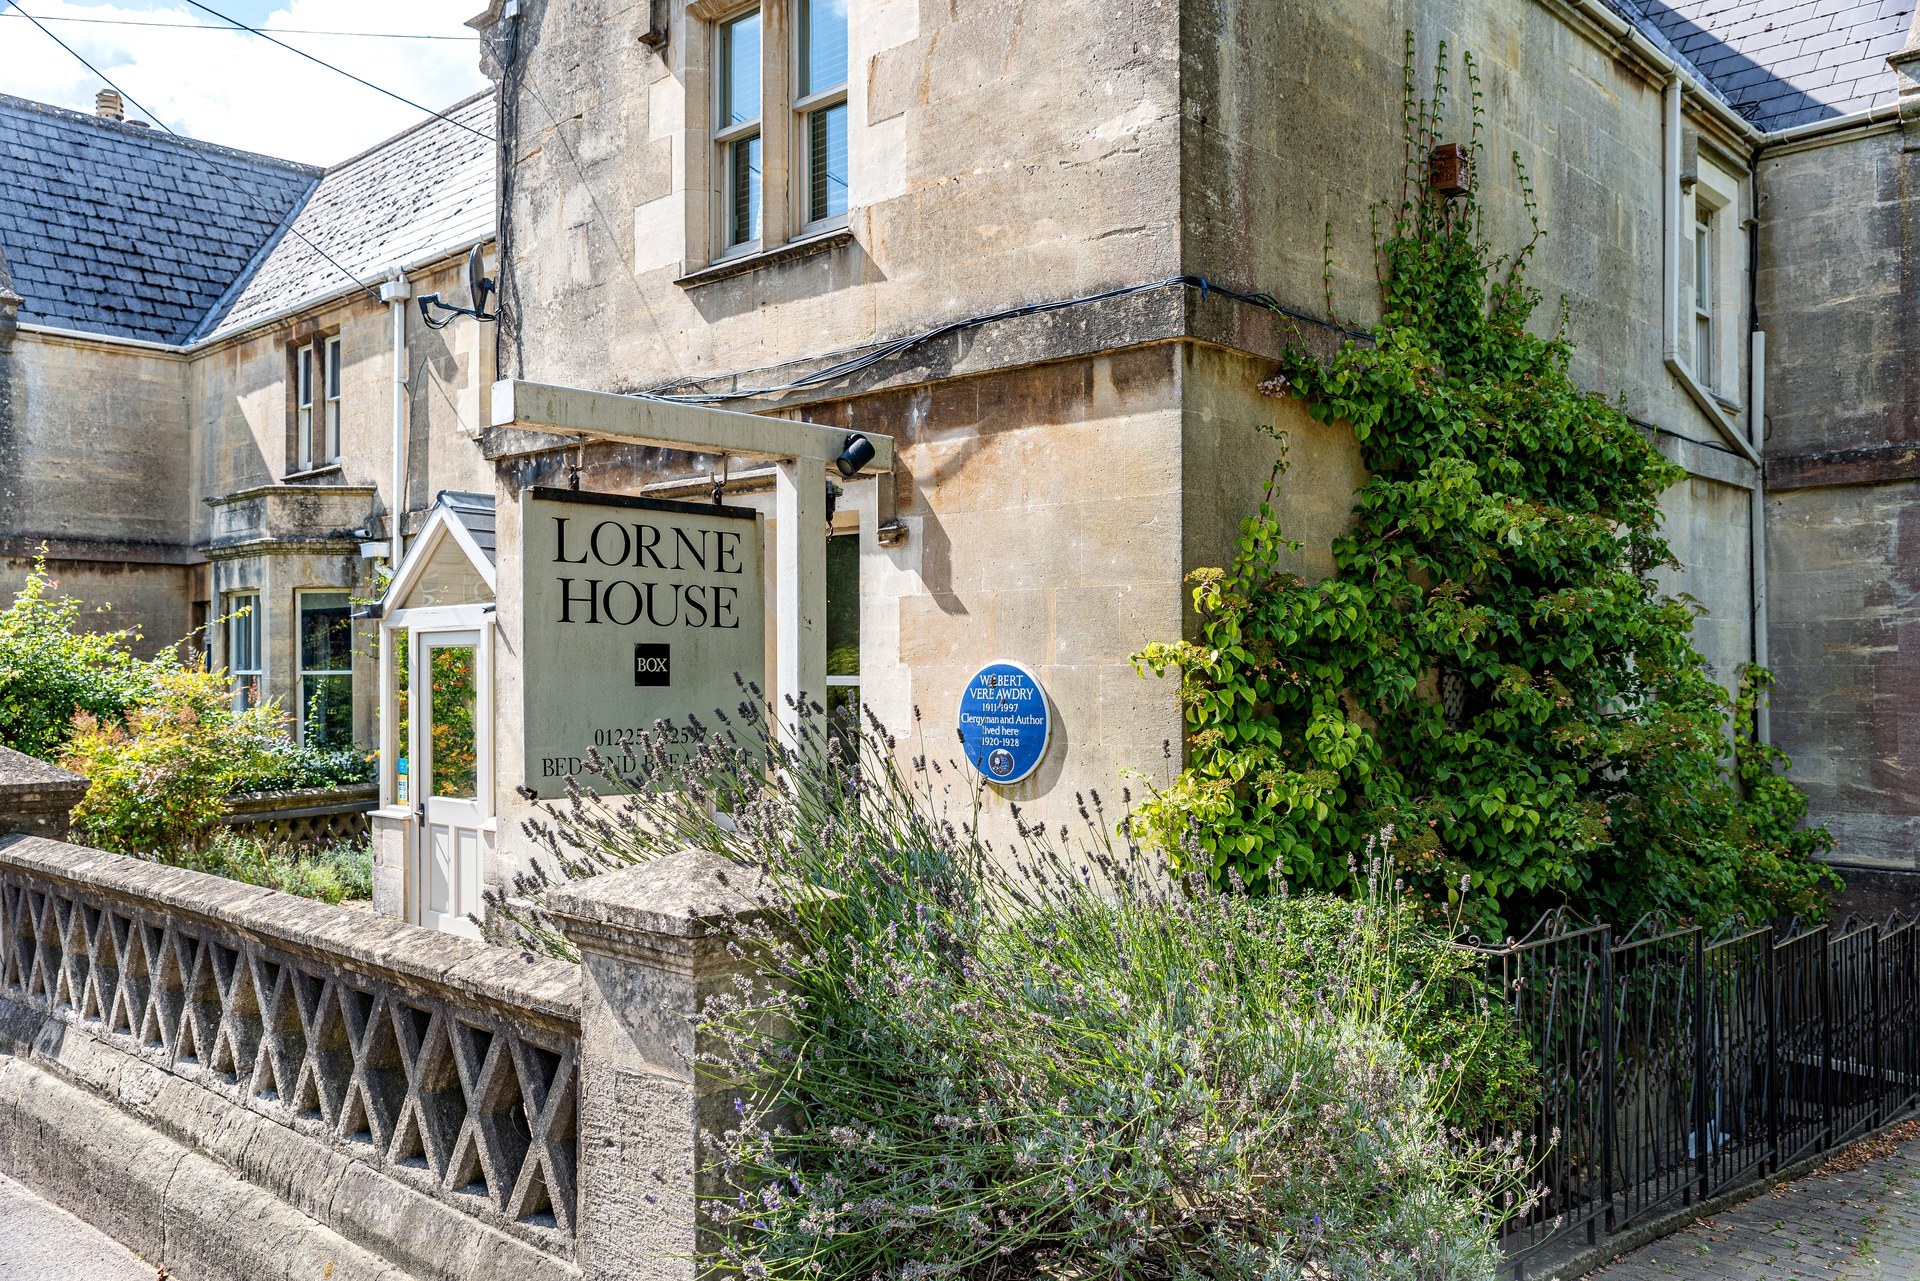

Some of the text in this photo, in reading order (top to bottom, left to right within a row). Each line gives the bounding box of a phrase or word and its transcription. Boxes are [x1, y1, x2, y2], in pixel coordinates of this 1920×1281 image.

[552, 516, 743, 574] LORNE
[556, 577, 740, 629] HOUSE
[637, 657, 668, 672] BOX
[979, 674, 1024, 687] WBERT
[969, 687, 1034, 700] VERE AWDRY
[982, 703, 1019, 713] 1911-1997
[961, 712, 1044, 727] Clergyman and Author
[982, 725, 1020, 736] lived here
[982, 737, 1020, 747] 1920-1928
[542, 757, 583, 777] BED
[588, 755, 637, 775] ND
